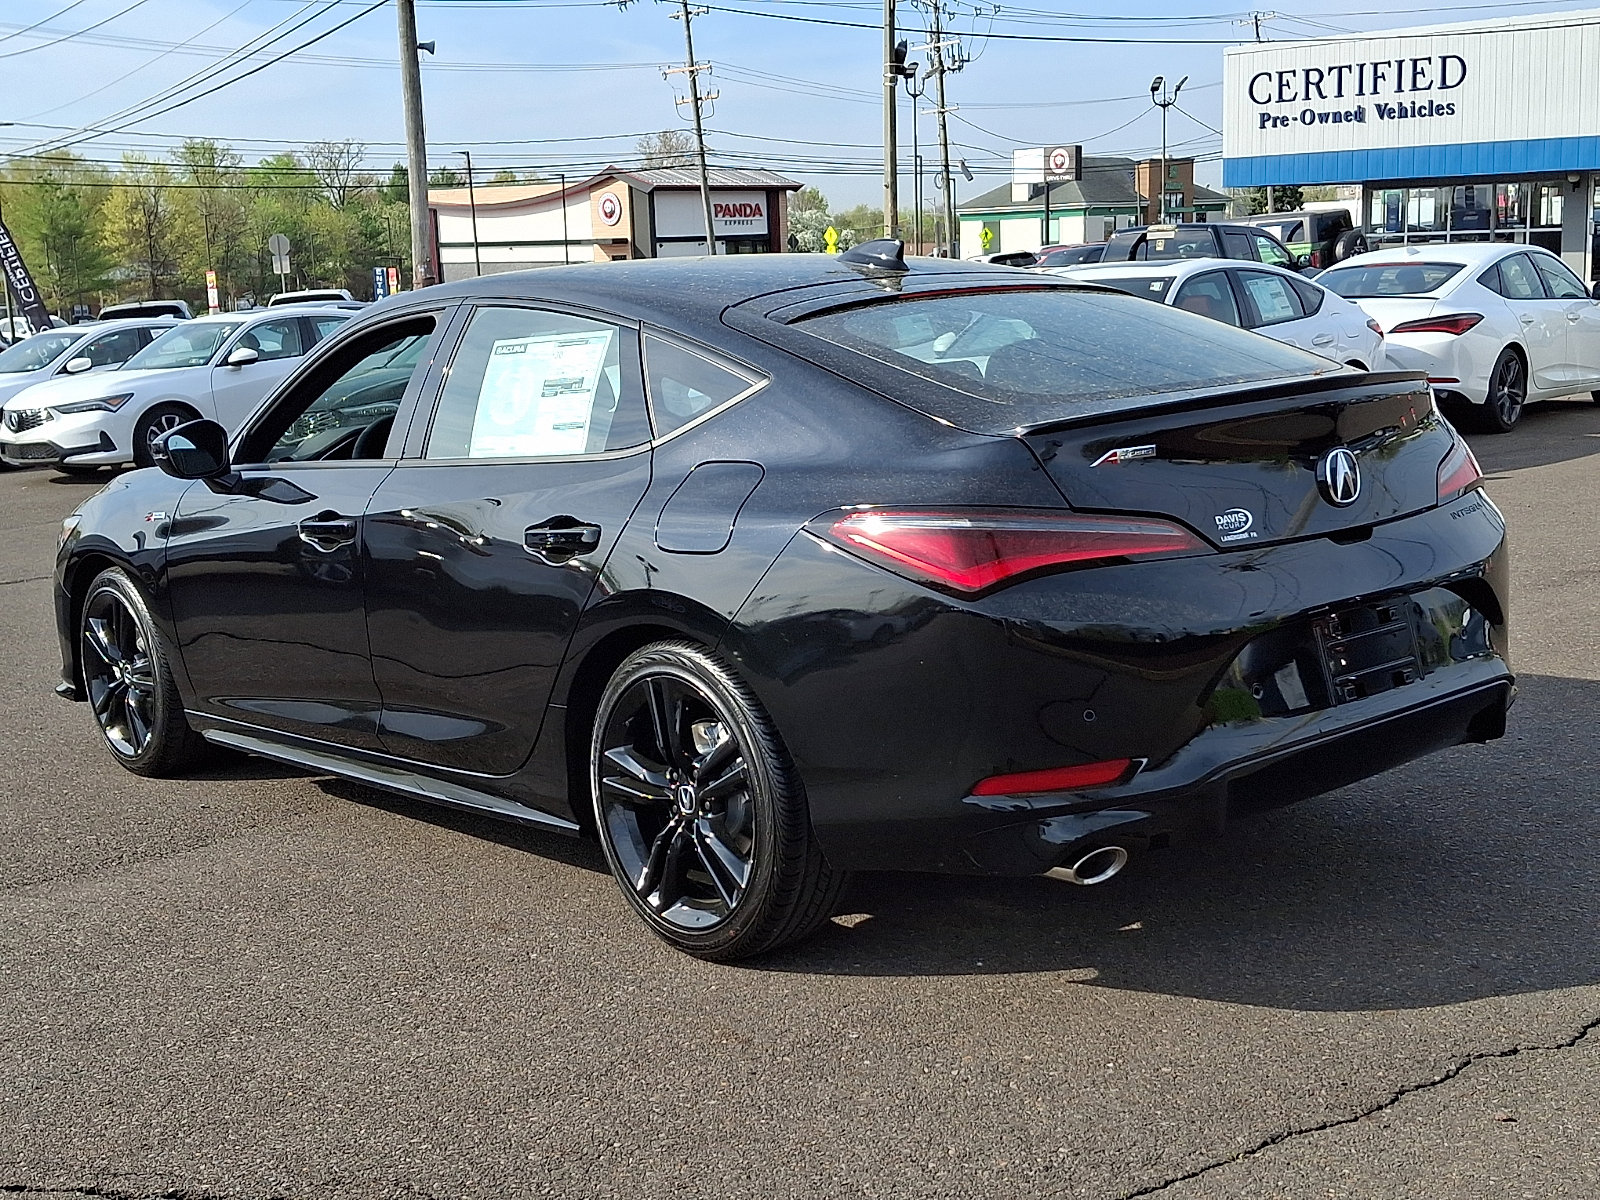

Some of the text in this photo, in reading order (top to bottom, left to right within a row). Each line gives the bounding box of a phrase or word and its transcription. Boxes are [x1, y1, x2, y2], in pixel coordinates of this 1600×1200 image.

[1248, 54, 1467, 105] CERTIFIED
[1259, 100, 1456, 129] Pre-Owned Vehicles
[713, 203, 763, 218] PANDA
[1214, 513, 1247, 525] DAVIS
[1217, 521, 1246, 530] ACURA
